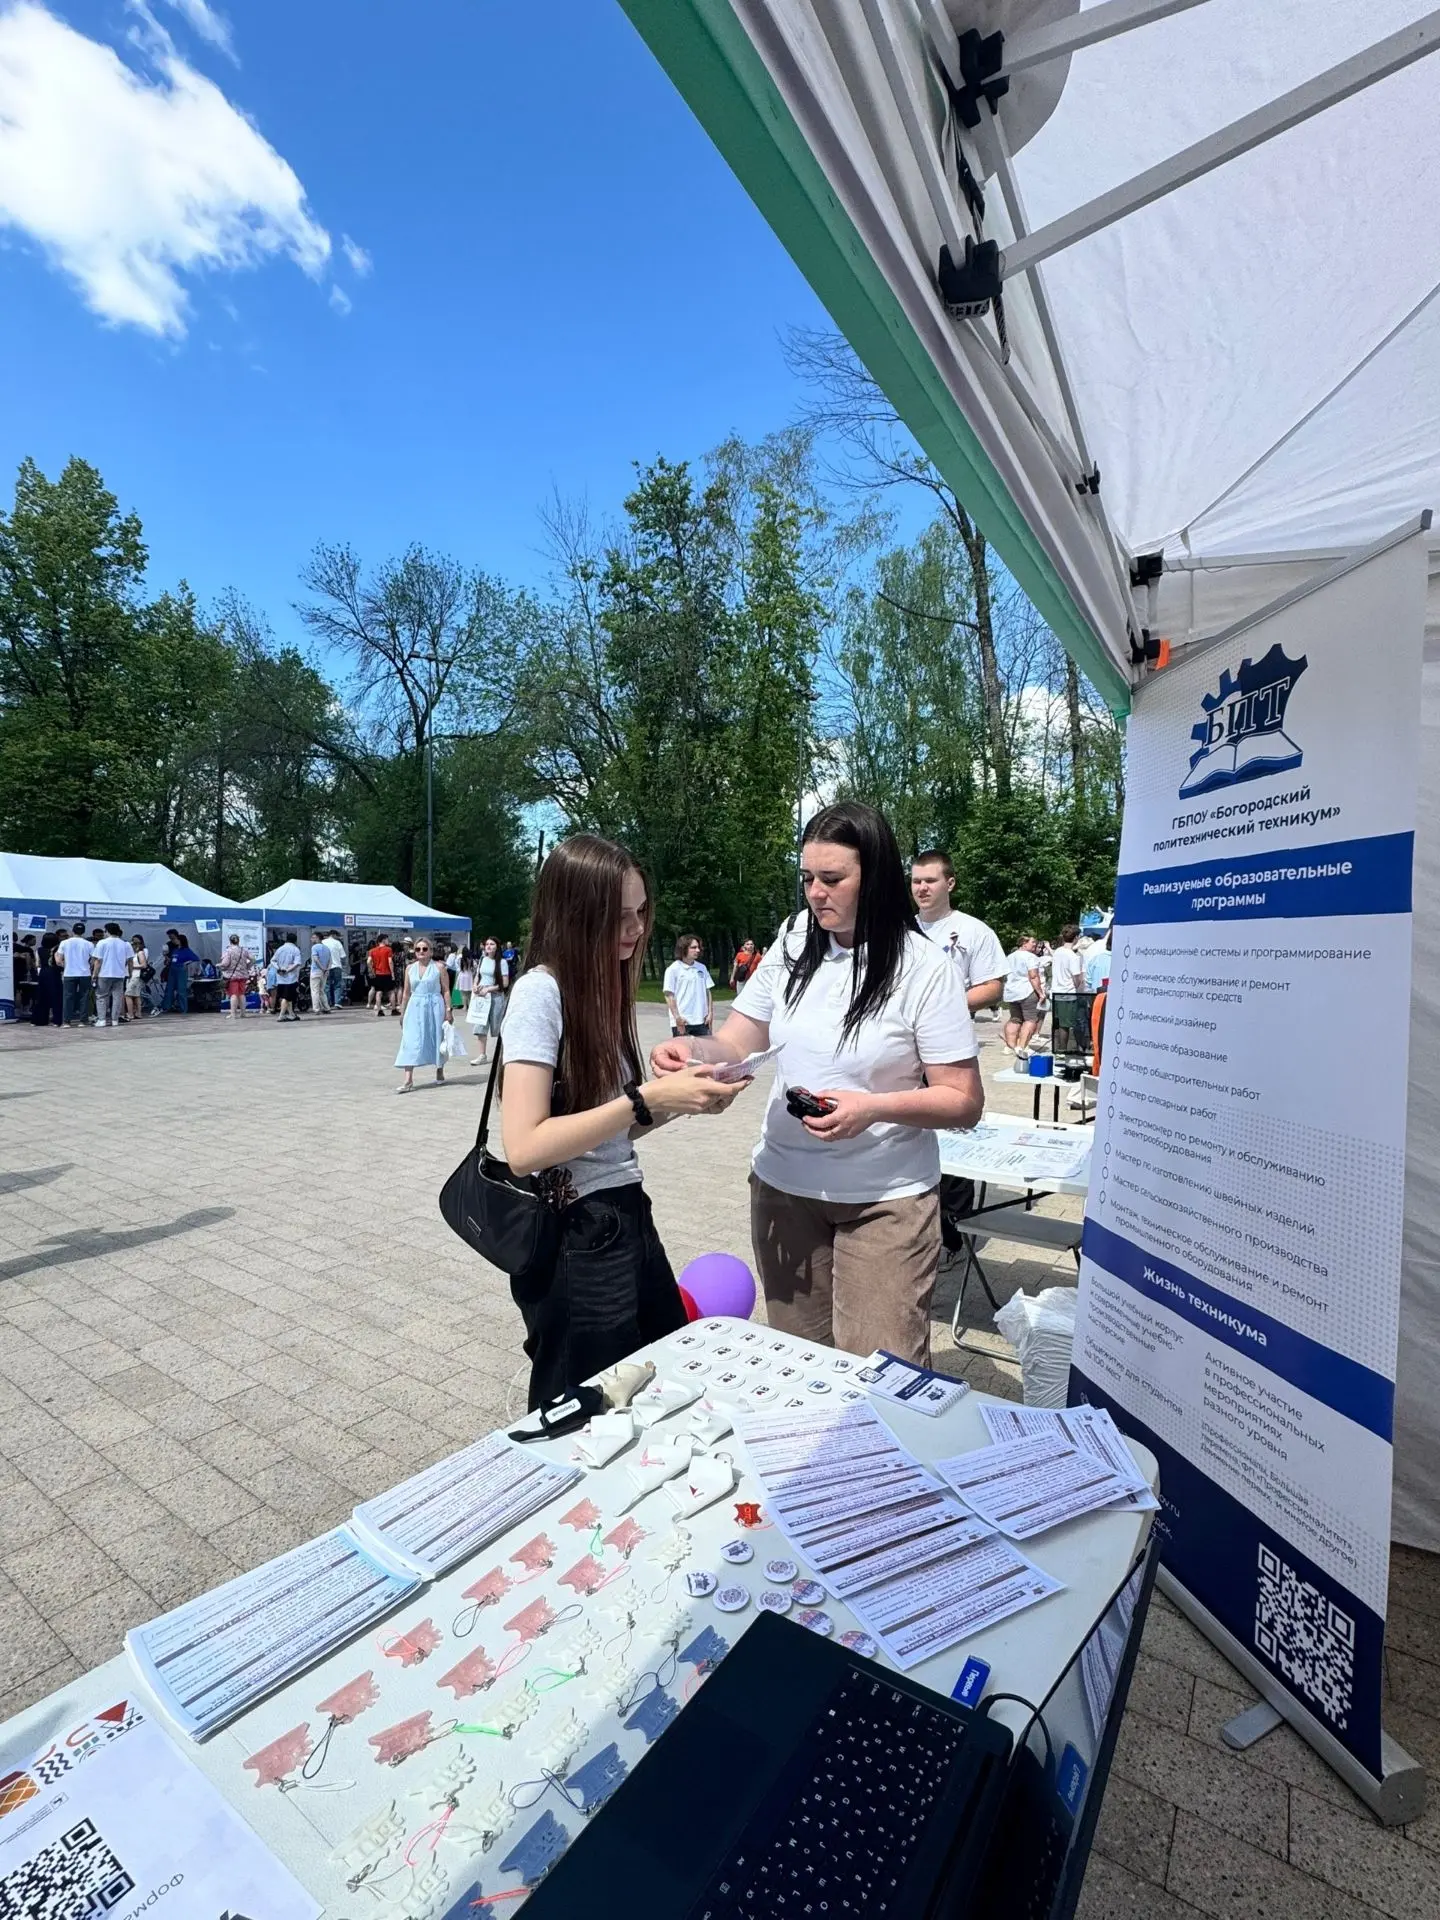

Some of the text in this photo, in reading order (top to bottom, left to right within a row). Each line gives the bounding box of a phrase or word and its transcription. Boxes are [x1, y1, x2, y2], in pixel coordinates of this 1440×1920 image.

[1204, 677, 1290, 747] БПТ
[1153, 805, 1341, 852] политехнический техникум»
[1172, 786, 1311, 830] ГБПОУ «Богородский
[1142, 859, 1353, 896] Реализуемые образовательные
[1191, 892, 1266, 910] программы
[1135, 947, 1371, 960] Информационные системы и программирование
[1132, 971, 1290, 992] Техническое обслуживание и ремонт
[1136, 987, 1243, 1003] автотранспортных средств
[1129, 1009, 1217, 1032] Графический дизайнер
[1126, 1035, 1228, 1063] Дошкольное образование
[1121, 1086, 1217, 1120] Мастер слесарных работ
[1123, 1060, 1148, 1076] Мастер
[1231, 1084, 1261, 1101] работ
[1118, 1111, 1326, 1187] Электромонтер по ремонту и обслуживанию
[1122, 1127, 1212, 1164] электрооборудования
[1115, 1149, 1142, 1166] Мастер
[1143, 1160, 1151, 1170] по
[1152, 1164, 1212, 1195] изготовлению
[1214, 1189, 1263, 1215] швейных
[1266, 1208, 1316, 1236] изделий
[1113, 1174, 1329, 1277] Мастер сельскохозяйственного производства
[1110, 1199, 1329, 1313] Монтаж, техническое обслуживание и ремонт
[1115, 1215, 1253, 1291] промышленного оборудования
[1121, 1298, 1153, 1325] учебный
[1155, 1319, 1185, 1344] корпус
[1143, 1265, 1267, 1347] Жизнь техникума
[1142, 1326, 1176, 1351] учебно-
[1085, 1335, 1183, 1416] Общежитие для студентов
[1205, 1352, 1303, 1421] Активное участие
[1203, 1396, 1288, 1460] разного уровня
[1204, 1381, 1283, 1441] мероприятиях
[1205, 1367, 1325, 1453] в профессиональных
[1200, 1443, 1240, 1476] Движение
[1275, 1501, 1282, 1510] и
[1284, 1507, 1317, 1537] многое
[1318, 1534, 1358, 1569] другое)
[1270, 1471, 1309, 1507] Большая
[961, 1668, 980, 1697] Первые
